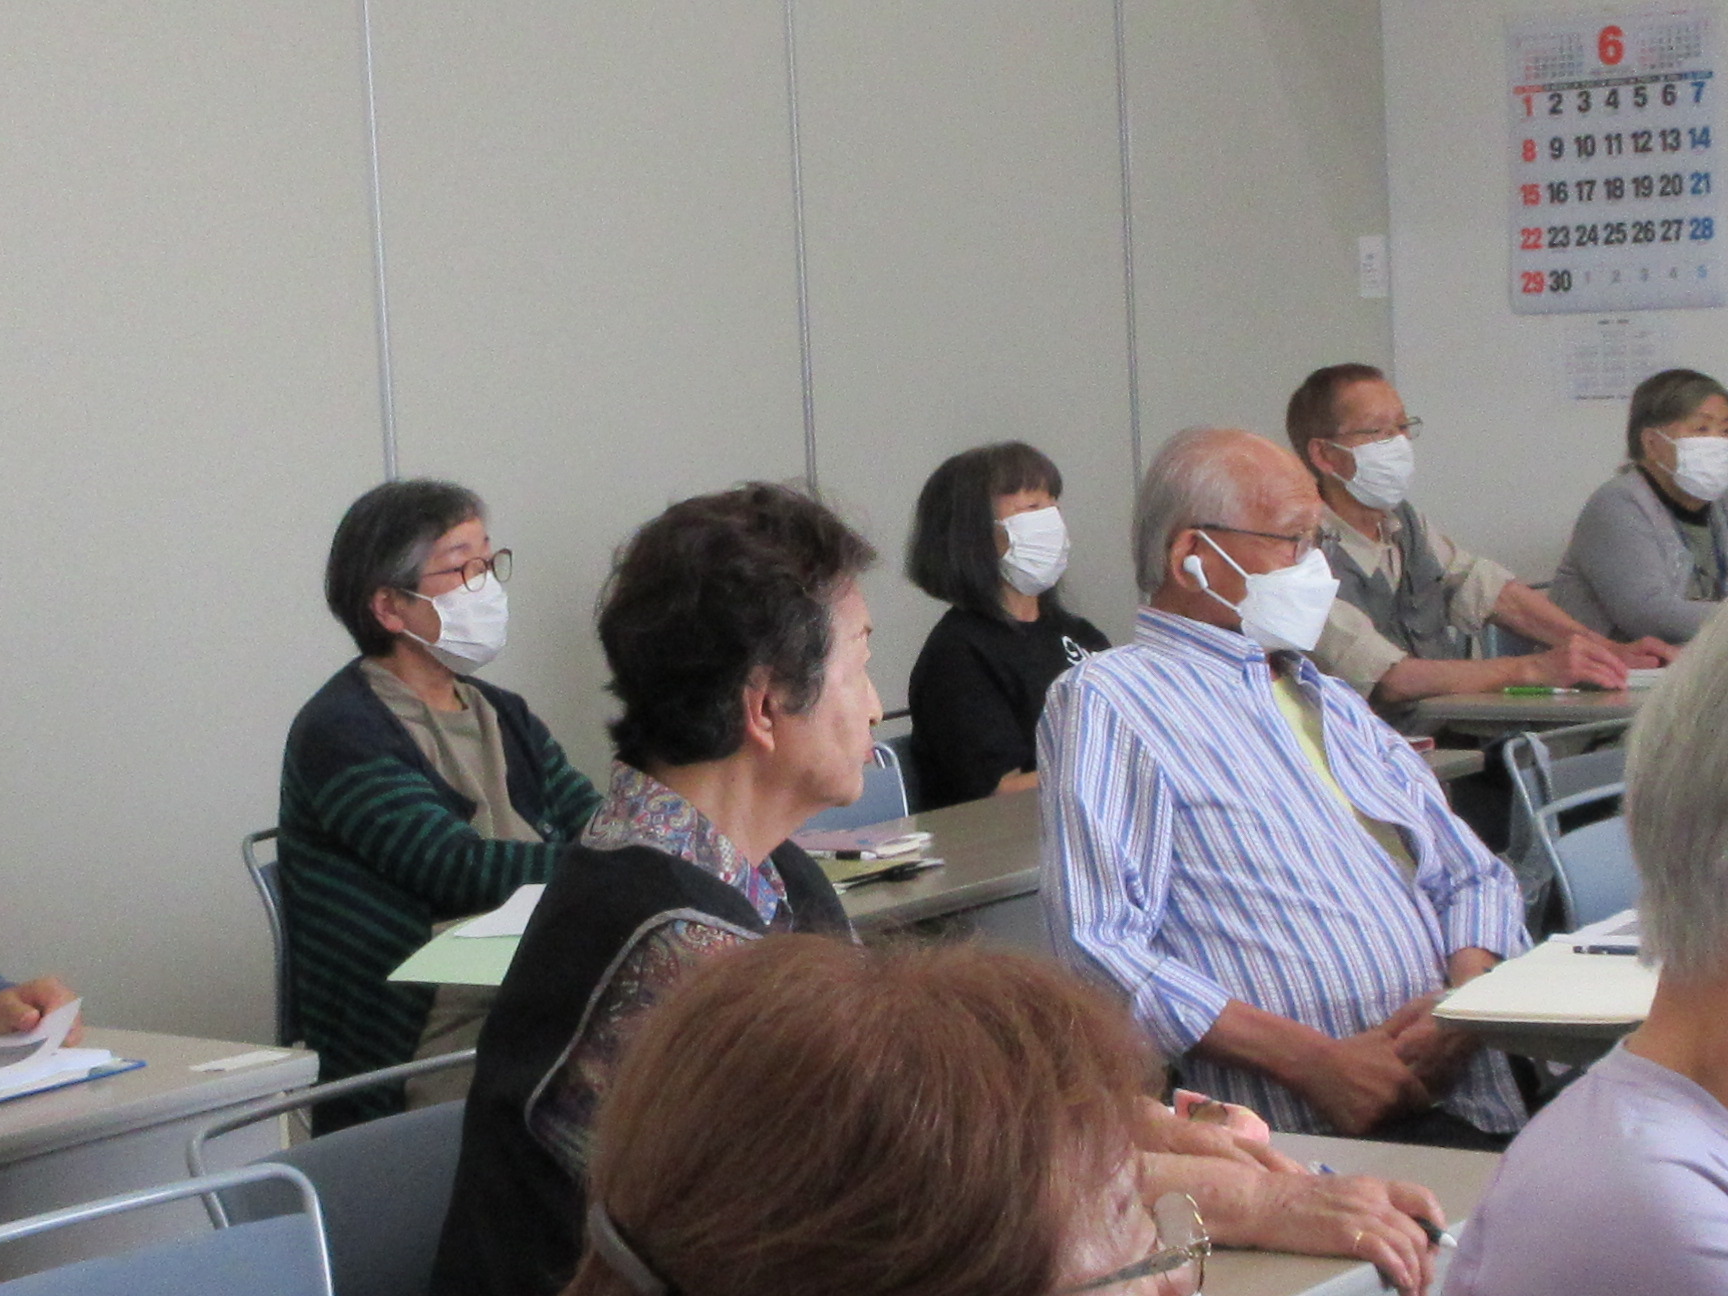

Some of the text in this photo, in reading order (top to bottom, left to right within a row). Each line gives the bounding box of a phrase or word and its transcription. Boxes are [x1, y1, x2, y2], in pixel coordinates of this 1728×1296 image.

[1597, 24, 1626, 66] 6
[1523, 95, 1534, 117] 1
[1549, 93, 1563, 115] 2
[1577, 90, 1591, 113] 3
[1604, 88, 1620, 110] 4
[1633, 86, 1647, 107] 5
[1661, 84, 1676, 105] 6
[1692, 81, 1705, 103] 7
[1522, 127, 1710, 162] 8 9 10 11 12 13 14
[1521, 172, 1710, 205] 15 16 17 18 19 20 21
[1521, 217, 1713, 250] 22 23 24 25 26 27 28
[1521, 272, 1544, 294] 29
[1549, 270, 1571, 292] 30
